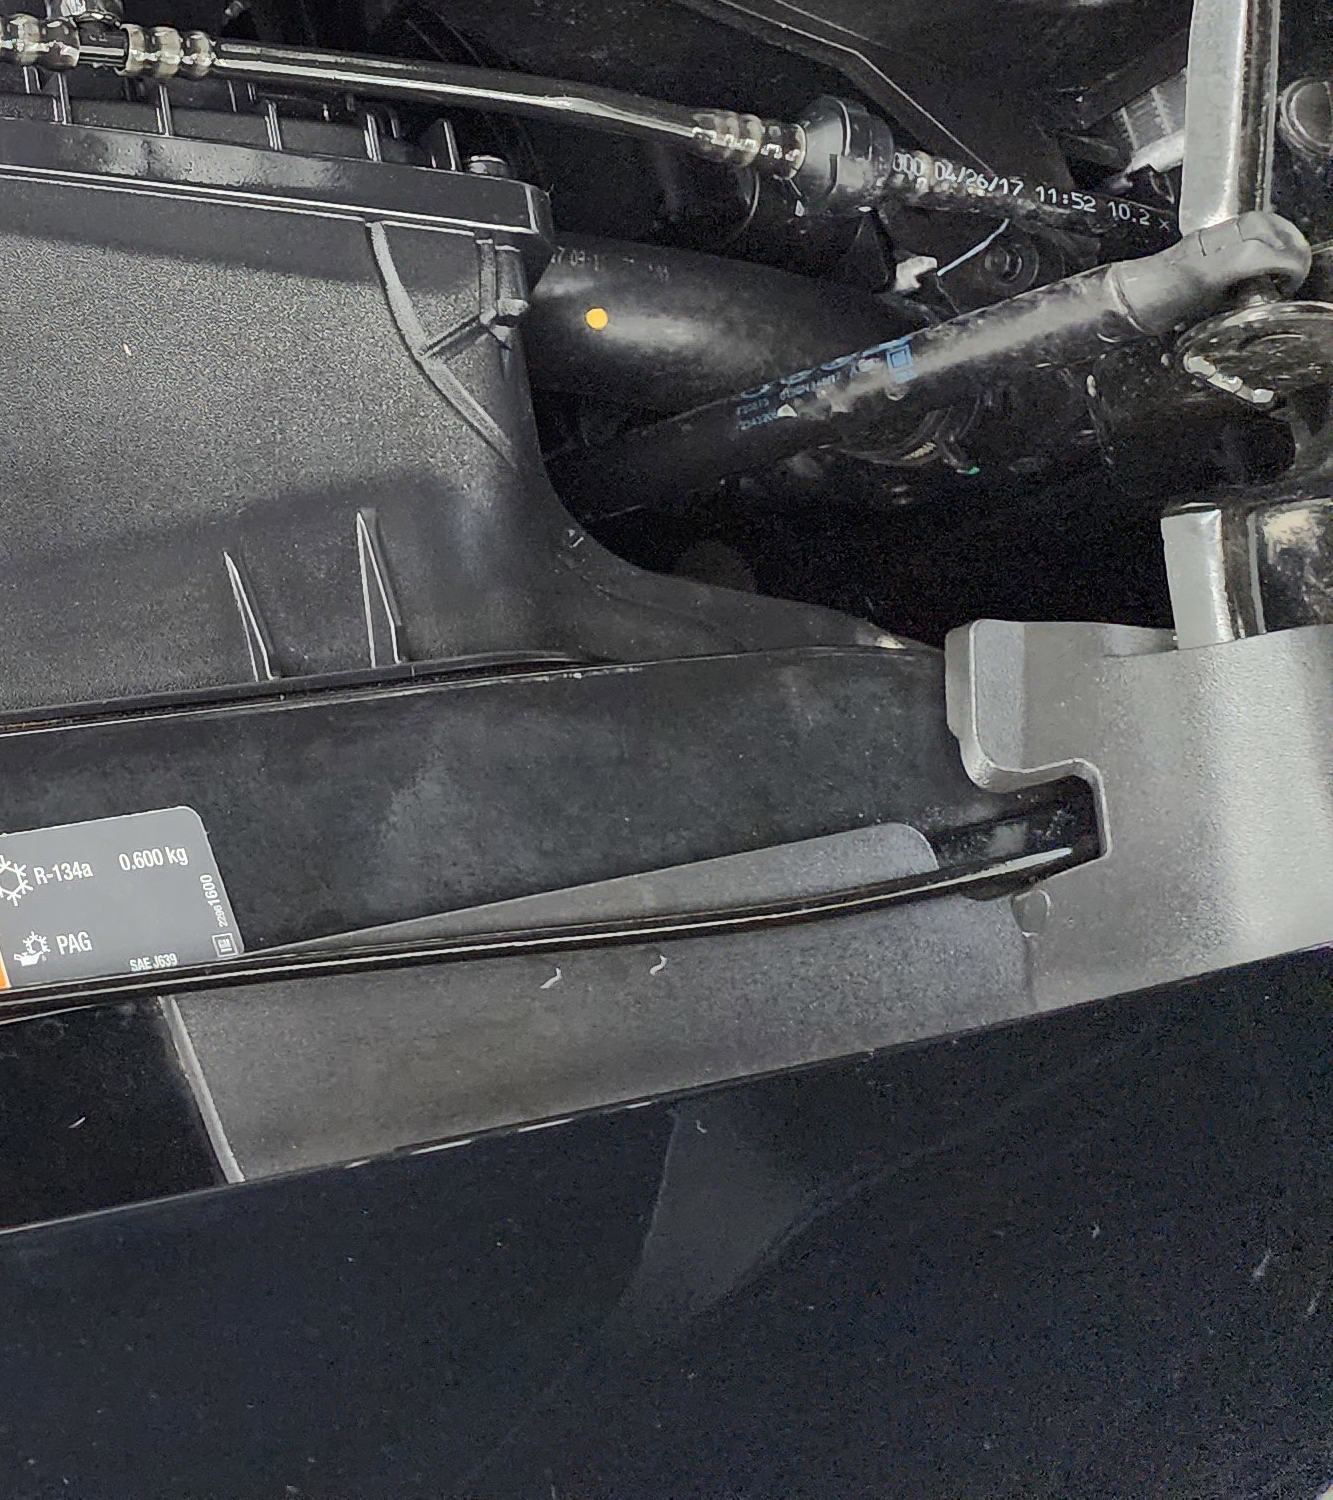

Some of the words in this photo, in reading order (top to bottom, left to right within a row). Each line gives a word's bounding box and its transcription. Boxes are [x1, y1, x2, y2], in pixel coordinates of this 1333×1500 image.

[933, 160, 1025, 197] 04/26/17
[1035, 185, 1097, 213] 11:52
[1107, 201, 1151, 226] 10.2
[33, 861, 94, 886] R-134a
[118, 847, 164, 872] 0.600
[165, 846, 190, 867] kg
[55, 930, 93, 955] PAG
[129, 956, 153, 973] SAE
[153, 952, 179, 970] J639
